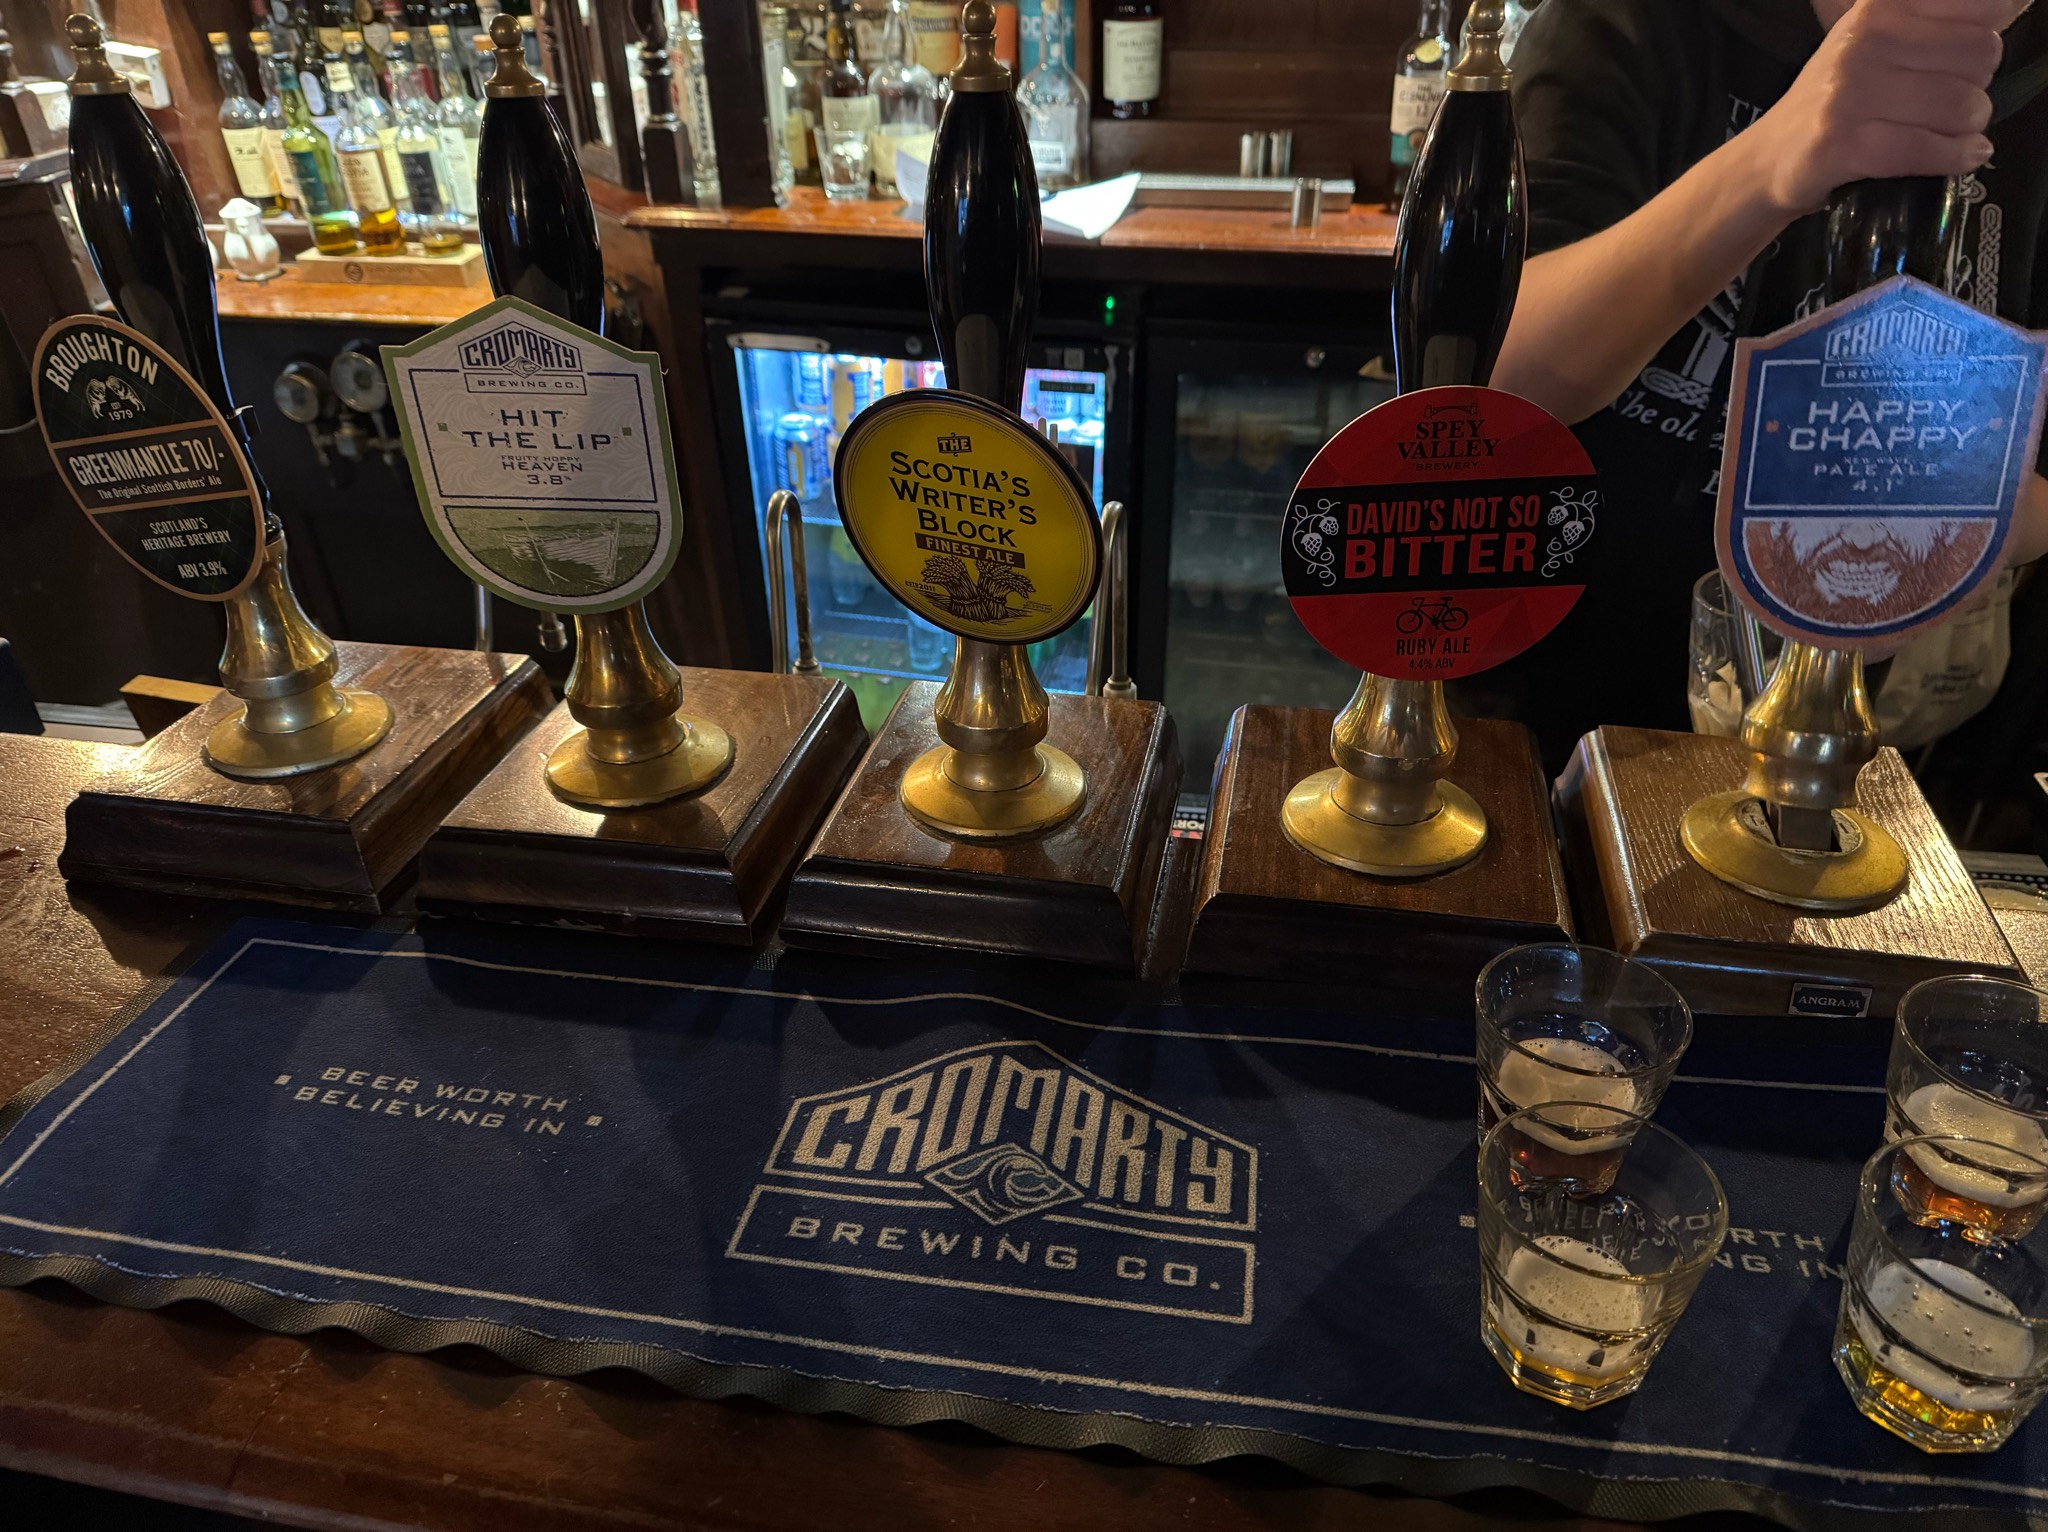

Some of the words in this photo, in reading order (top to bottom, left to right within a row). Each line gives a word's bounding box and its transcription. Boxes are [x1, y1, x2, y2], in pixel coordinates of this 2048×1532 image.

[1831, 309, 1963, 357] CROMARTY
[463, 328, 579, 369] CROMARTY
[46, 332, 159, 393] BROUGHTON
[477, 378, 547, 389] BREWING
[554, 380, 579, 390] CO.
[108, 409, 134, 421] 1979
[501, 408, 563, 428] HIT
[1808, 399, 1968, 425] HAPPY
[1415, 419, 1486, 440] SPEY
[1788, 426, 1975, 451] CHAPPY
[461, 430, 538, 450] THE
[552, 433, 612, 451] LIP
[938, 437, 970, 451] THE
[1396, 438, 1501, 460] VALLEY
[68, 441, 190, 486] GREENMANTLE
[502, 461, 583, 472] HEAVEN
[1415, 461, 1479, 472] BREWERY
[1813, 463, 1878, 477] PALE
[1889, 462, 1939, 477] ALE
[97, 489, 113, 500] The
[114, 486, 142, 499] Original
[142, 481, 174, 494] Scottish
[208, 475, 223, 486] Ale
[1346, 500, 1446, 535] DAVID'S
[1452, 496, 1503, 531] NOT
[1507, 494, 1541, 528] SO
[149, 516, 209, 535] SCOTLAND'S
[917, 508, 1018, 548] BLOCK
[140, 535, 187, 551] HERITAGE
[185, 530, 231, 547] BREWERY
[925, 536, 983, 559] FINEST
[985, 548, 1016, 566] ALE
[1344, 531, 1537, 580] BITTER
[177, 562, 200, 579] ABV
[198, 561, 228, 577] 3.9%
[919, 582, 936, 592] 2011
[1396, 638, 1438, 656] RUBY
[1442, 637, 1472, 654] ALE
[1408, 658, 1433, 670] 4.4%
[1435, 657, 1456, 669] ABV
[1798, 995, 1861, 1009] ANGRAM
[320, 1066, 420, 1094] BEER
[434, 1084, 569, 1113] WORTH
[293, 1086, 506, 1128] BELIEVING
[523, 1117, 566, 1136] IN
[792, 1054, 1234, 1214] CROMARTY
[787, 1217, 1080, 1270] BREWING
[1116, 1255, 1222, 1291] CO.
